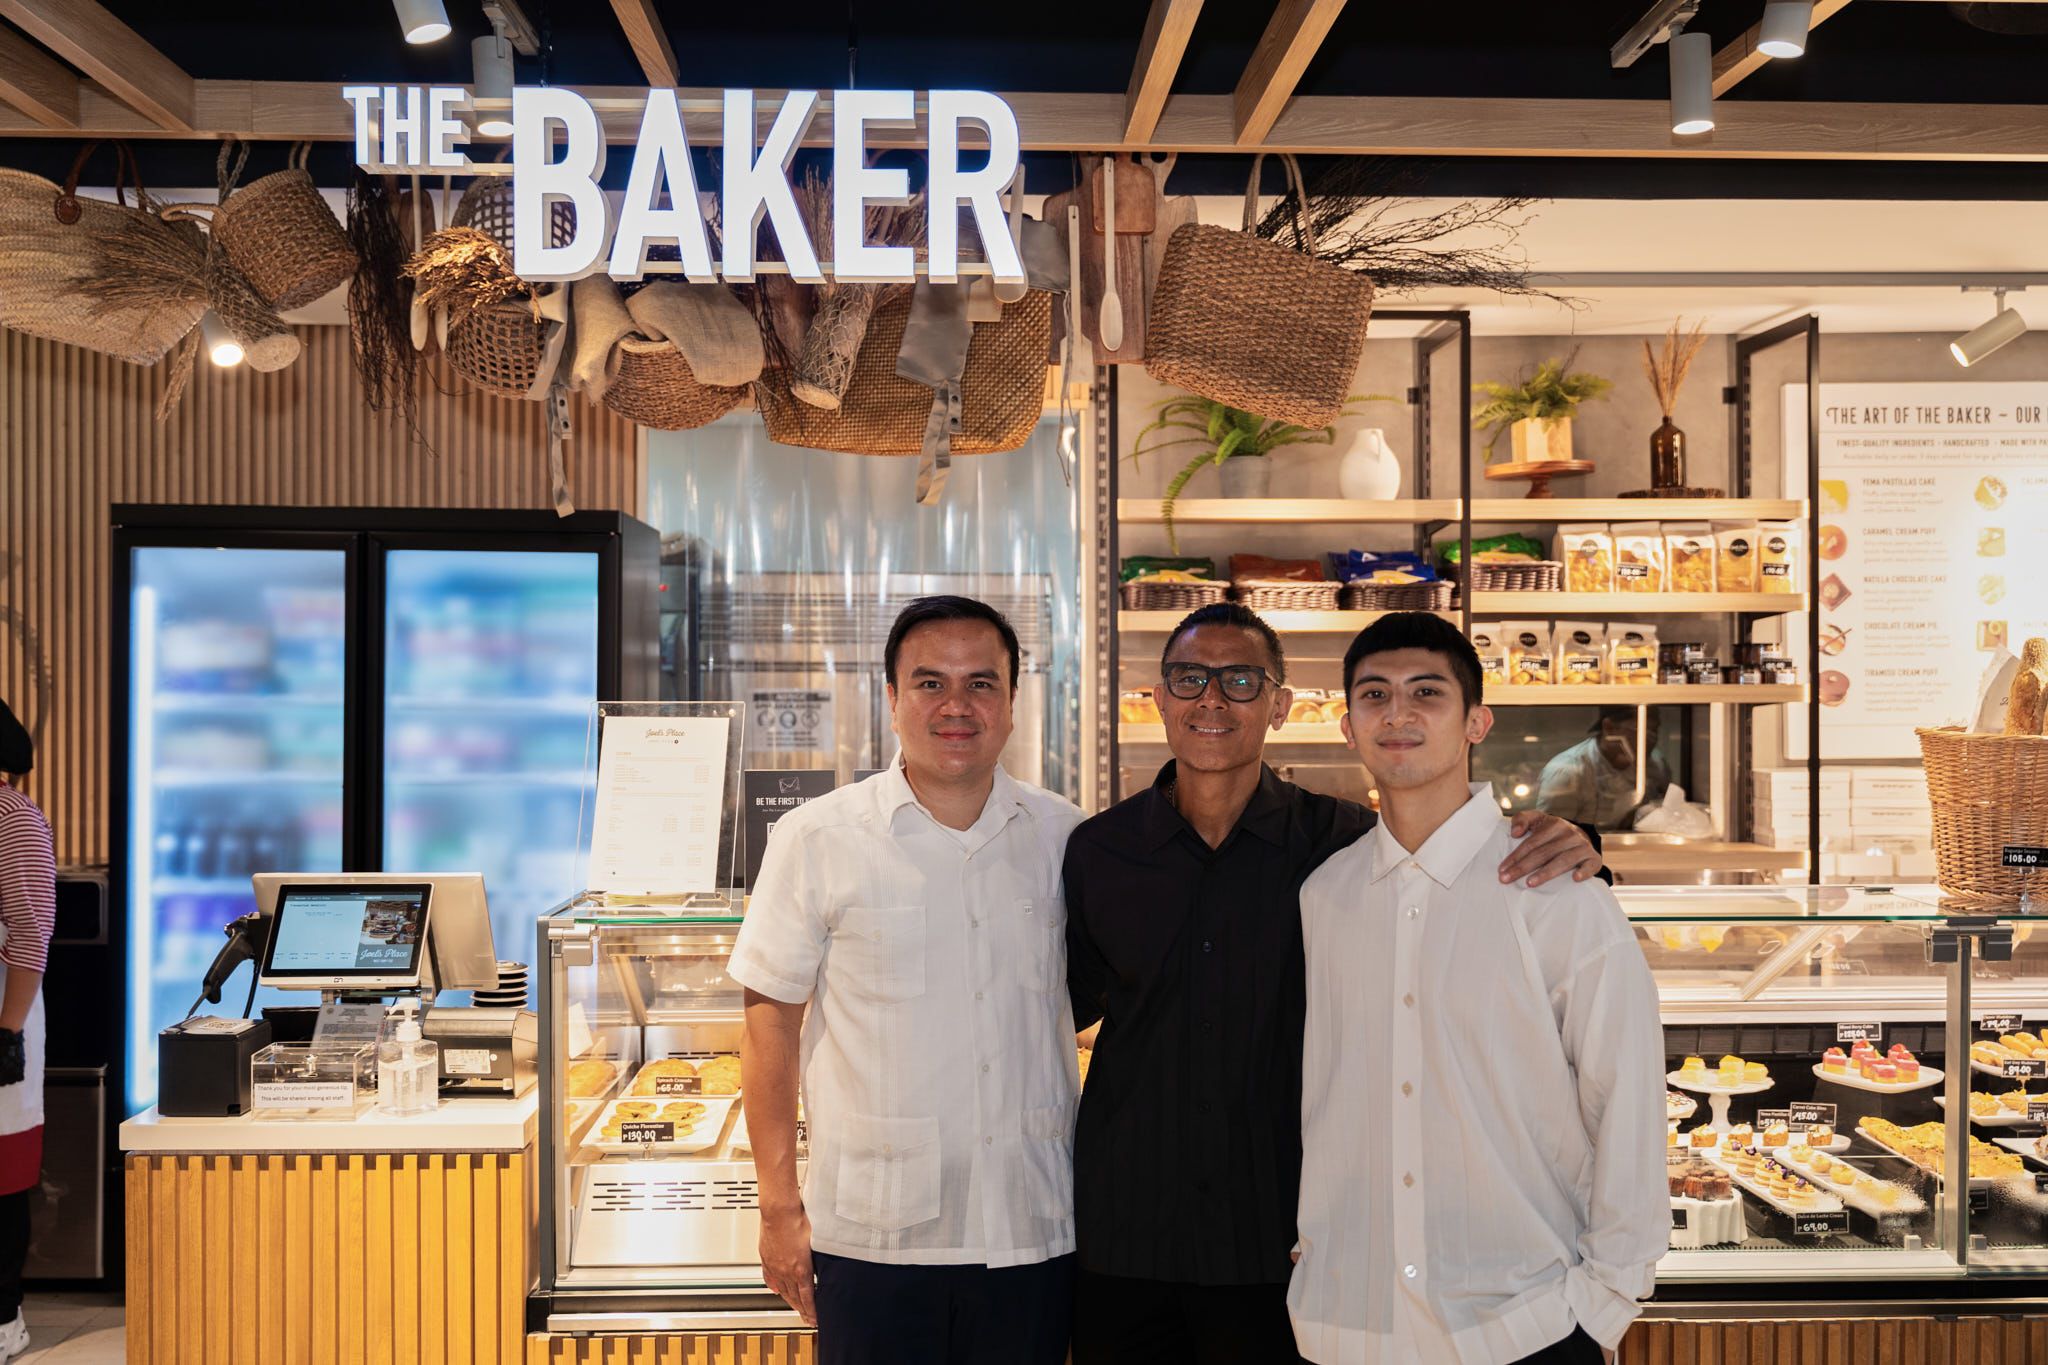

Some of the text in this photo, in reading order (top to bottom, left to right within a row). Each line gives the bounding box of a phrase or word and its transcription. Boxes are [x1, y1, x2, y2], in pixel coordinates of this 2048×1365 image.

[343, 86, 1025, 283] THE BAKER
[1826, 406, 1857, 424] THE
[1864, 406, 1888, 424] ART
[1894, 406, 1909, 424] OF
[1916, 406, 1941, 424] THE
[1947, 406, 1991, 424] BAKER
[2016, 406, 2040, 424] OUR
[1943, 439, 1989, 447] HANDCRAFTED
[756, 797, 764, 806] BE
[765, 797, 777, 806] THE
[778, 797, 795, 806] FIRST
[797, 797, 804, 806] TO
[384, 948, 408, 958] Place
